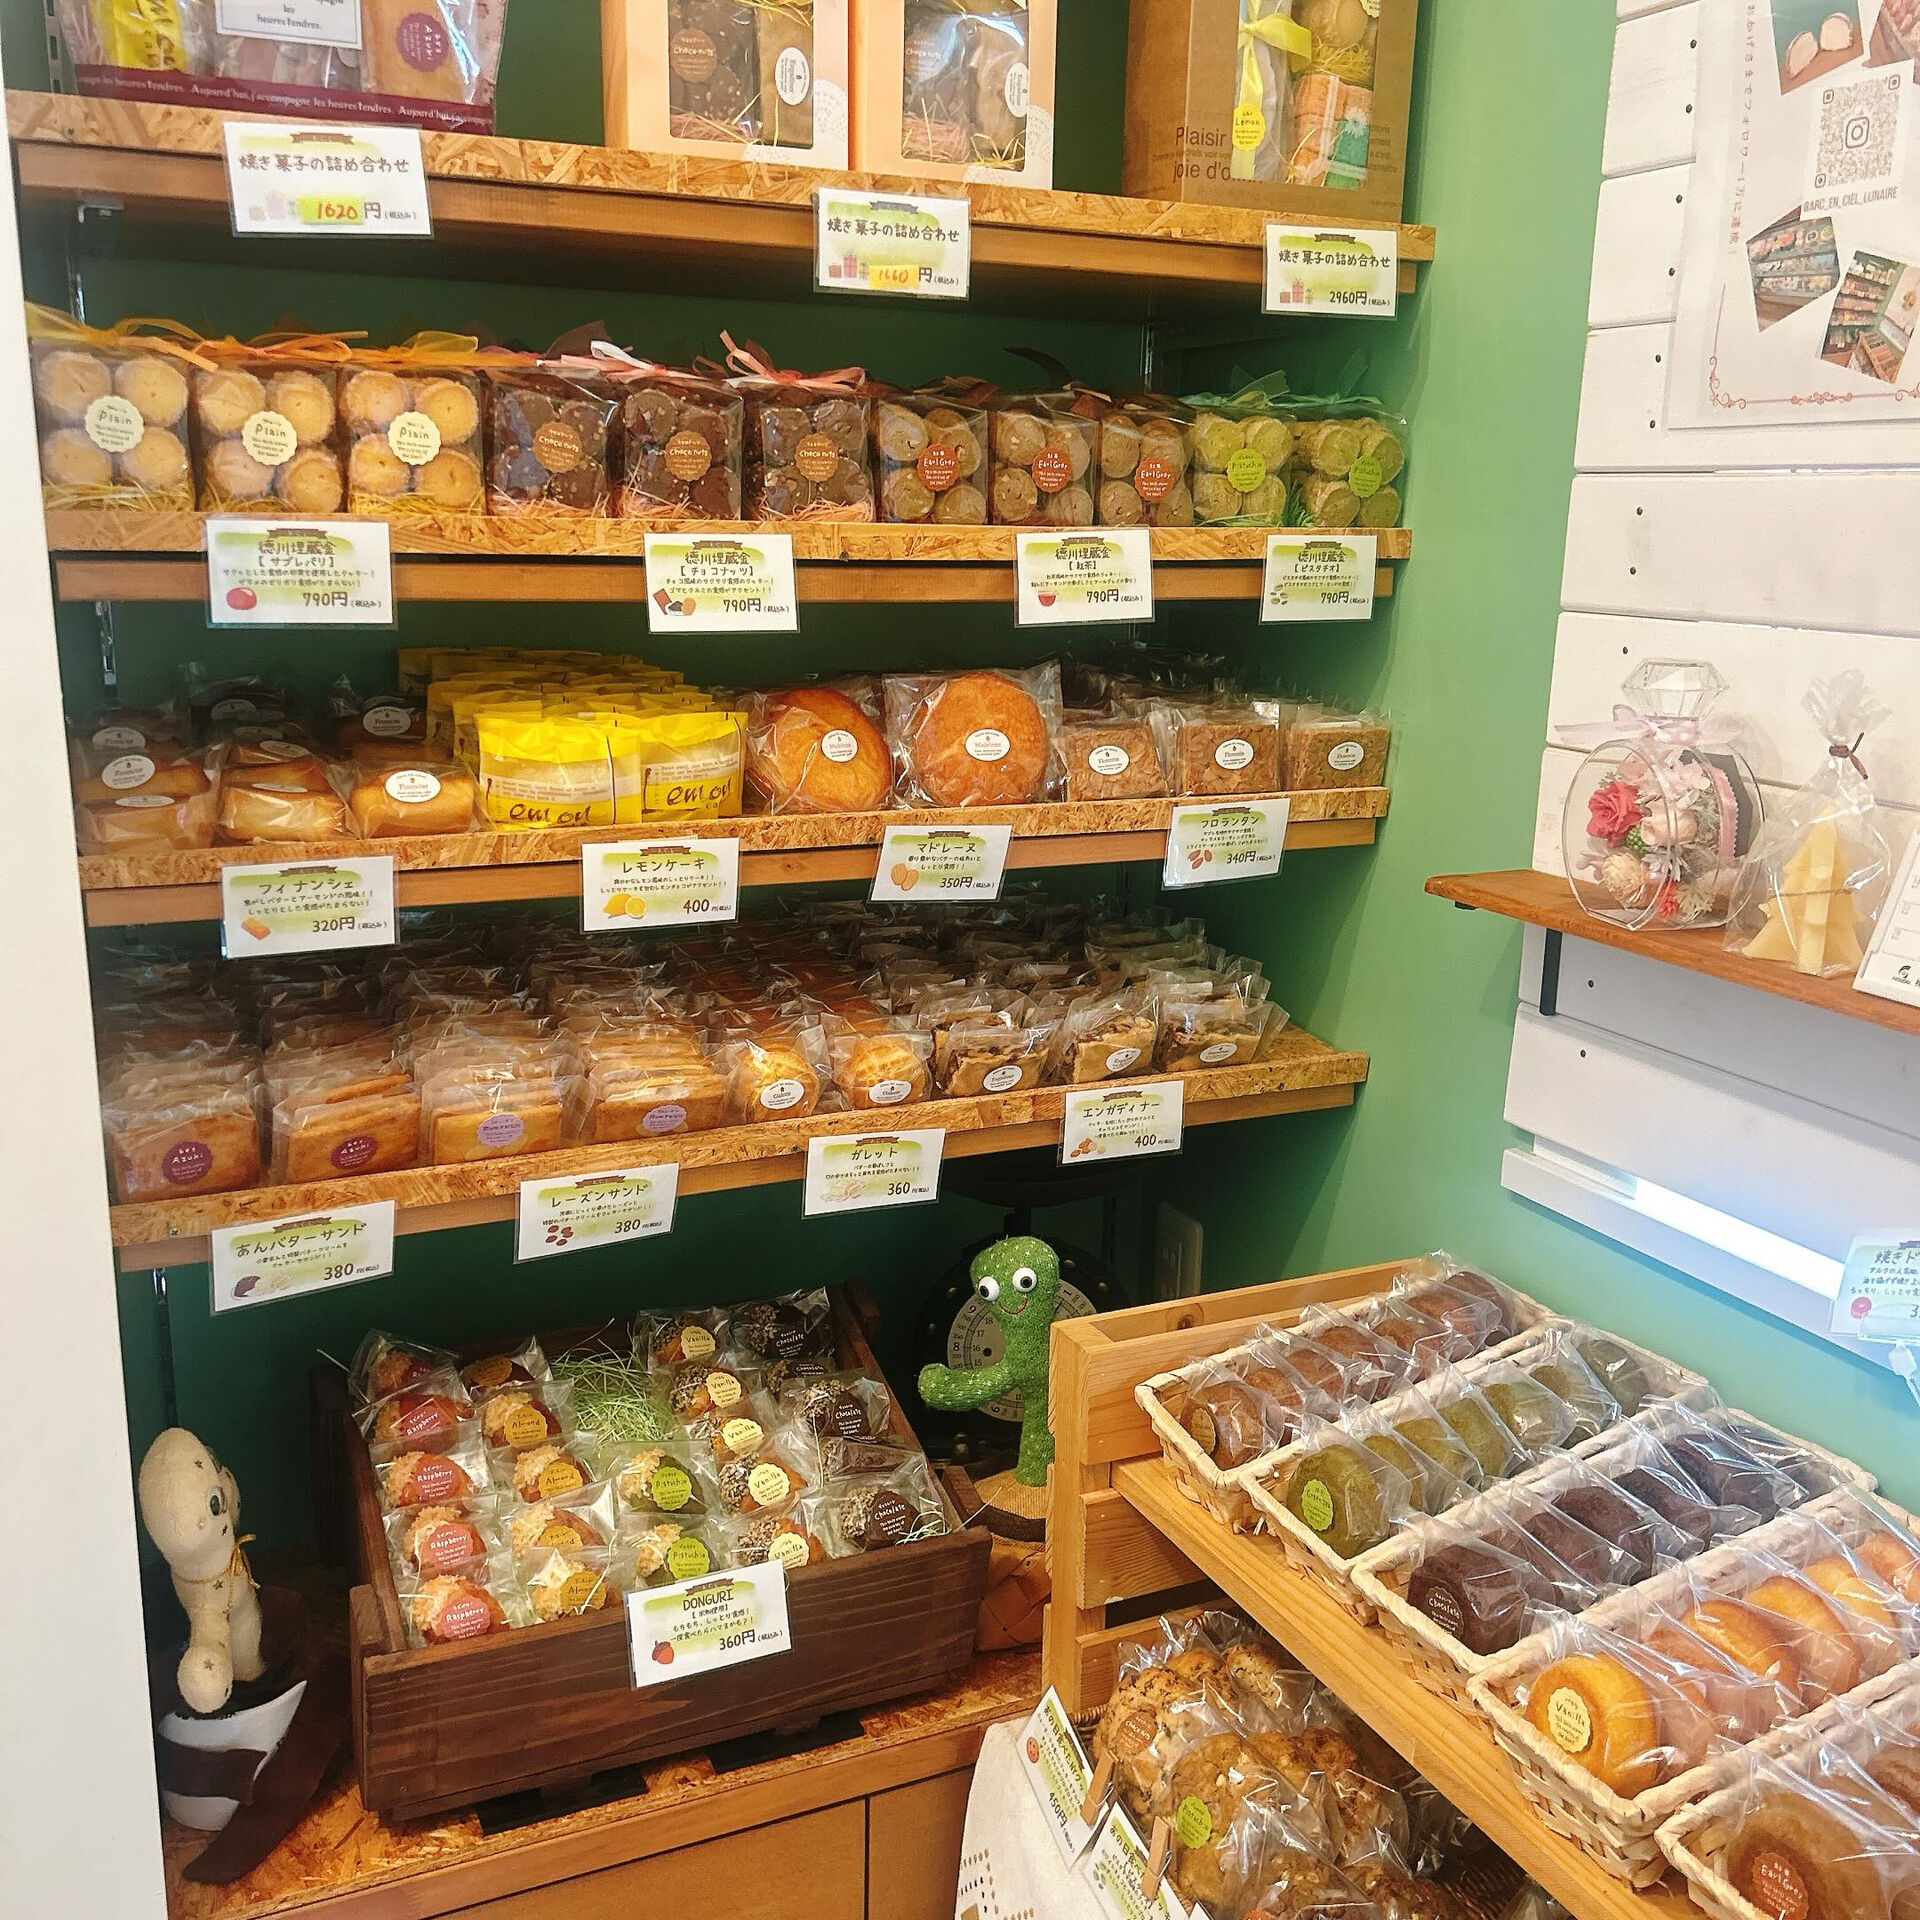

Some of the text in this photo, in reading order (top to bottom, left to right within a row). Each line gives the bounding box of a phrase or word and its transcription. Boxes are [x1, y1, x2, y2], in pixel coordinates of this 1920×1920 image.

[1175, 126, 1227, 147] Plaisir
[239, 153, 410, 175] 焼き菓子の詰め合わせ
[1172, 159, 1201, 184] joie
[827, 217, 960, 243] 焼き菓子の詰め合わせ
[1278, 250, 1391, 268] 焼き菓子の詰め合わせ
[99, 409, 133, 425] Plain
[255, 423, 286, 438] Plain
[400, 426, 429, 440] Plain
[258, 541, 335, 556] 徳川埋蔵金
[1055, 546, 1111, 560] 徳川埋蔵金
[685, 551, 751, 566] 徳川埋蔵金
[1298, 550, 1347, 563] 徳川埋蔵金
[680, 565, 754, 577] 【チョコナッツ】
[1069, 560, 1097, 571] 【紅茶】
[1294, 563, 1340, 573] 【ピスタチオ】
[302, 591, 348, 607] 790円
[1086, 589, 1119, 603] 790円
[1321, 591, 1349, 605] 790円
[723, 598, 761, 613] 790円
[1201, 816, 1260, 829] フロランタン
[917, 842, 976, 853] マドレーヌ
[1226, 851, 1257, 865] 340円
[623, 858, 705, 874] レモンケーキ
[259, 878, 354, 895] フィナンシェ
[940, 876, 973, 889] 350円
[683, 899, 710, 915] 400
[312, 916, 355, 933] 320円
[1082, 1101, 1160, 1119] エンガディナー
[341, 1144, 370, 1154] Azuki
[1134, 1134, 1157, 1149] 400
[172, 1153, 204, 1164] Azuki
[851, 1147, 898, 1161] ガレット
[551, 1183, 649, 1208] レーズンサンド
[887, 1181, 911, 1197] 360
[614, 1218, 641, 1234] 380
[236, 1222, 367, 1258] あんバターサンド
[323, 1263, 354, 1281] 380
[976, 1330, 985, 1338] 17
[953, 1342, 961, 1352] 8
[972, 1344, 982, 1352] 16
[406, 1412, 438, 1436] Raspberry
[512, 1418, 541, 1429] Almond
[417, 1470, 453, 1483] Raspberry
[874, 1503, 906, 1520] Chocolate
[431, 1534, 467, 1549] Raspberry
[682, 1588, 735, 1612] DONGURI
[446, 1607, 484, 1622] Raspberry
[719, 1628, 756, 1651] 360円
[1555, 1702, 1585, 1727] Vanilla
